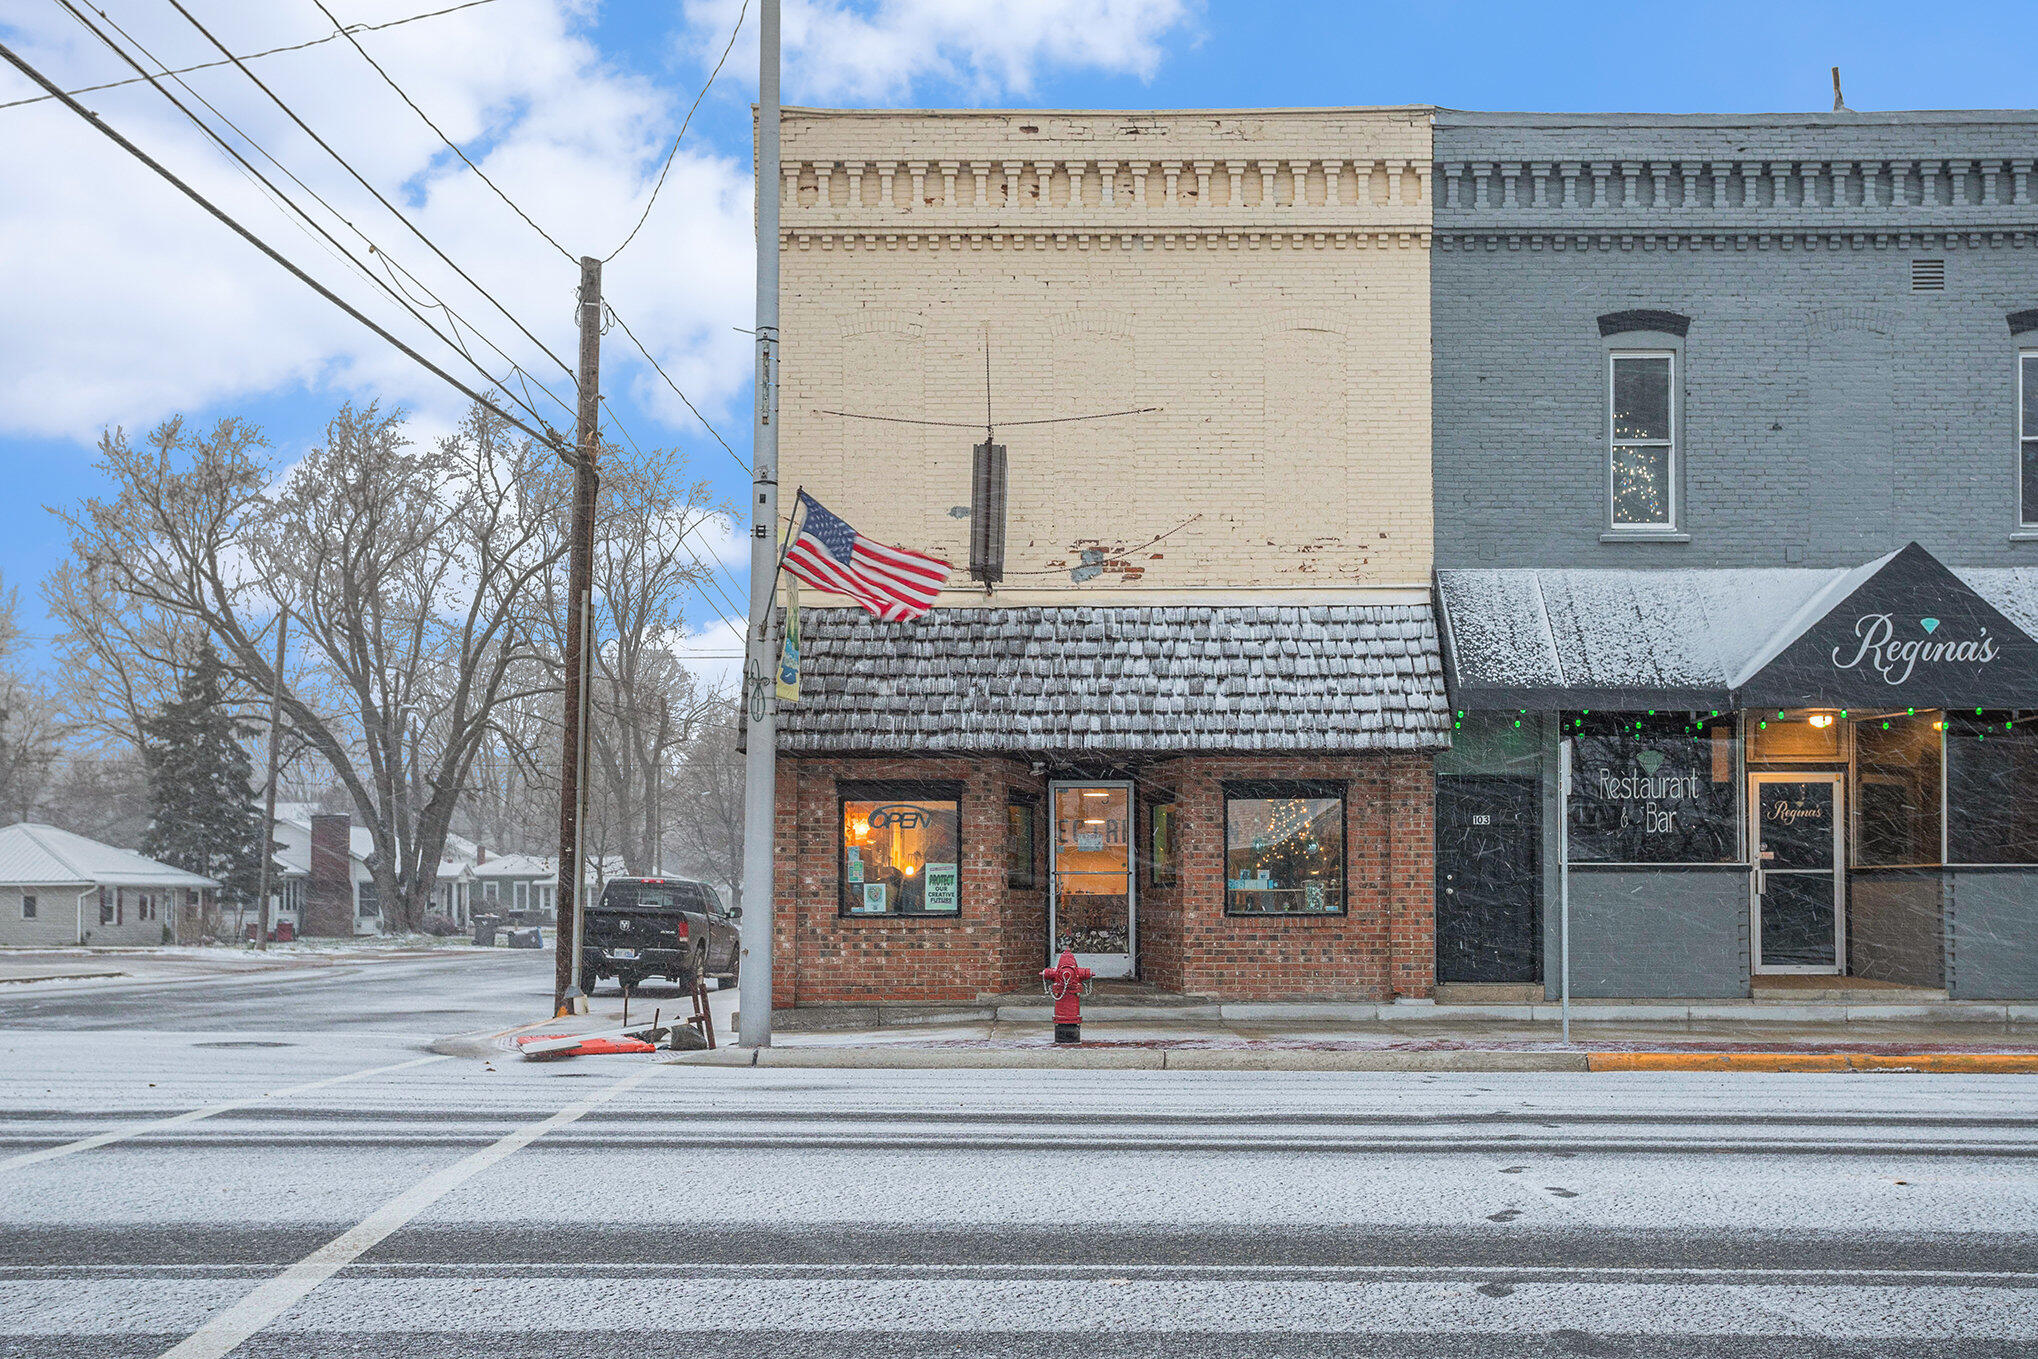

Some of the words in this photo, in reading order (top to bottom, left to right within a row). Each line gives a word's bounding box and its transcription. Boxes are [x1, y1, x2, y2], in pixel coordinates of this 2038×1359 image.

[1832, 612, 1999, 686] Regina's
[1600, 768, 1700, 800] Restaurant
[868, 805, 931, 829] OPEN
[1474, 815, 1489, 824] 103
[1620, 807, 1629, 829] &
[1646, 802, 1677, 833] Bar
[1767, 800, 1823, 825] Regina's
